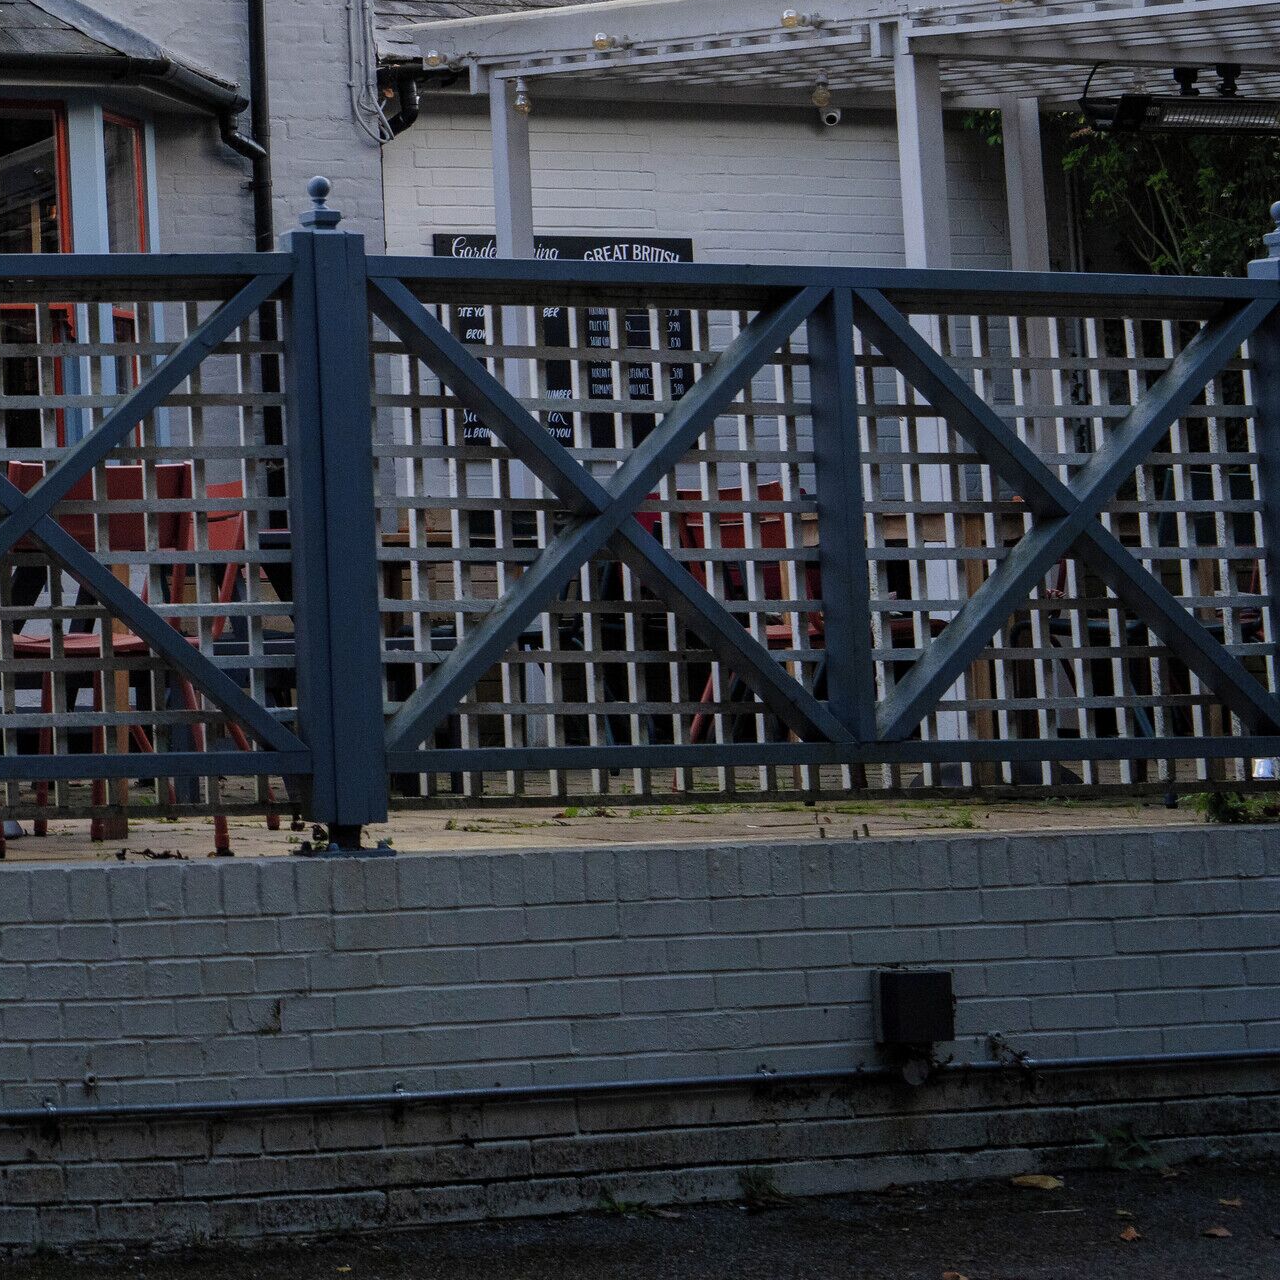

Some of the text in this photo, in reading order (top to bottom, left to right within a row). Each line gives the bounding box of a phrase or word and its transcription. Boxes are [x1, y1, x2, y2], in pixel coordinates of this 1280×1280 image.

[451, 236, 497, 259] Garde
[584, 244, 680, 263] GREAT BRITISH
[473, 427, 492, 439] BRIN
[555, 427, 572, 439] YOU
